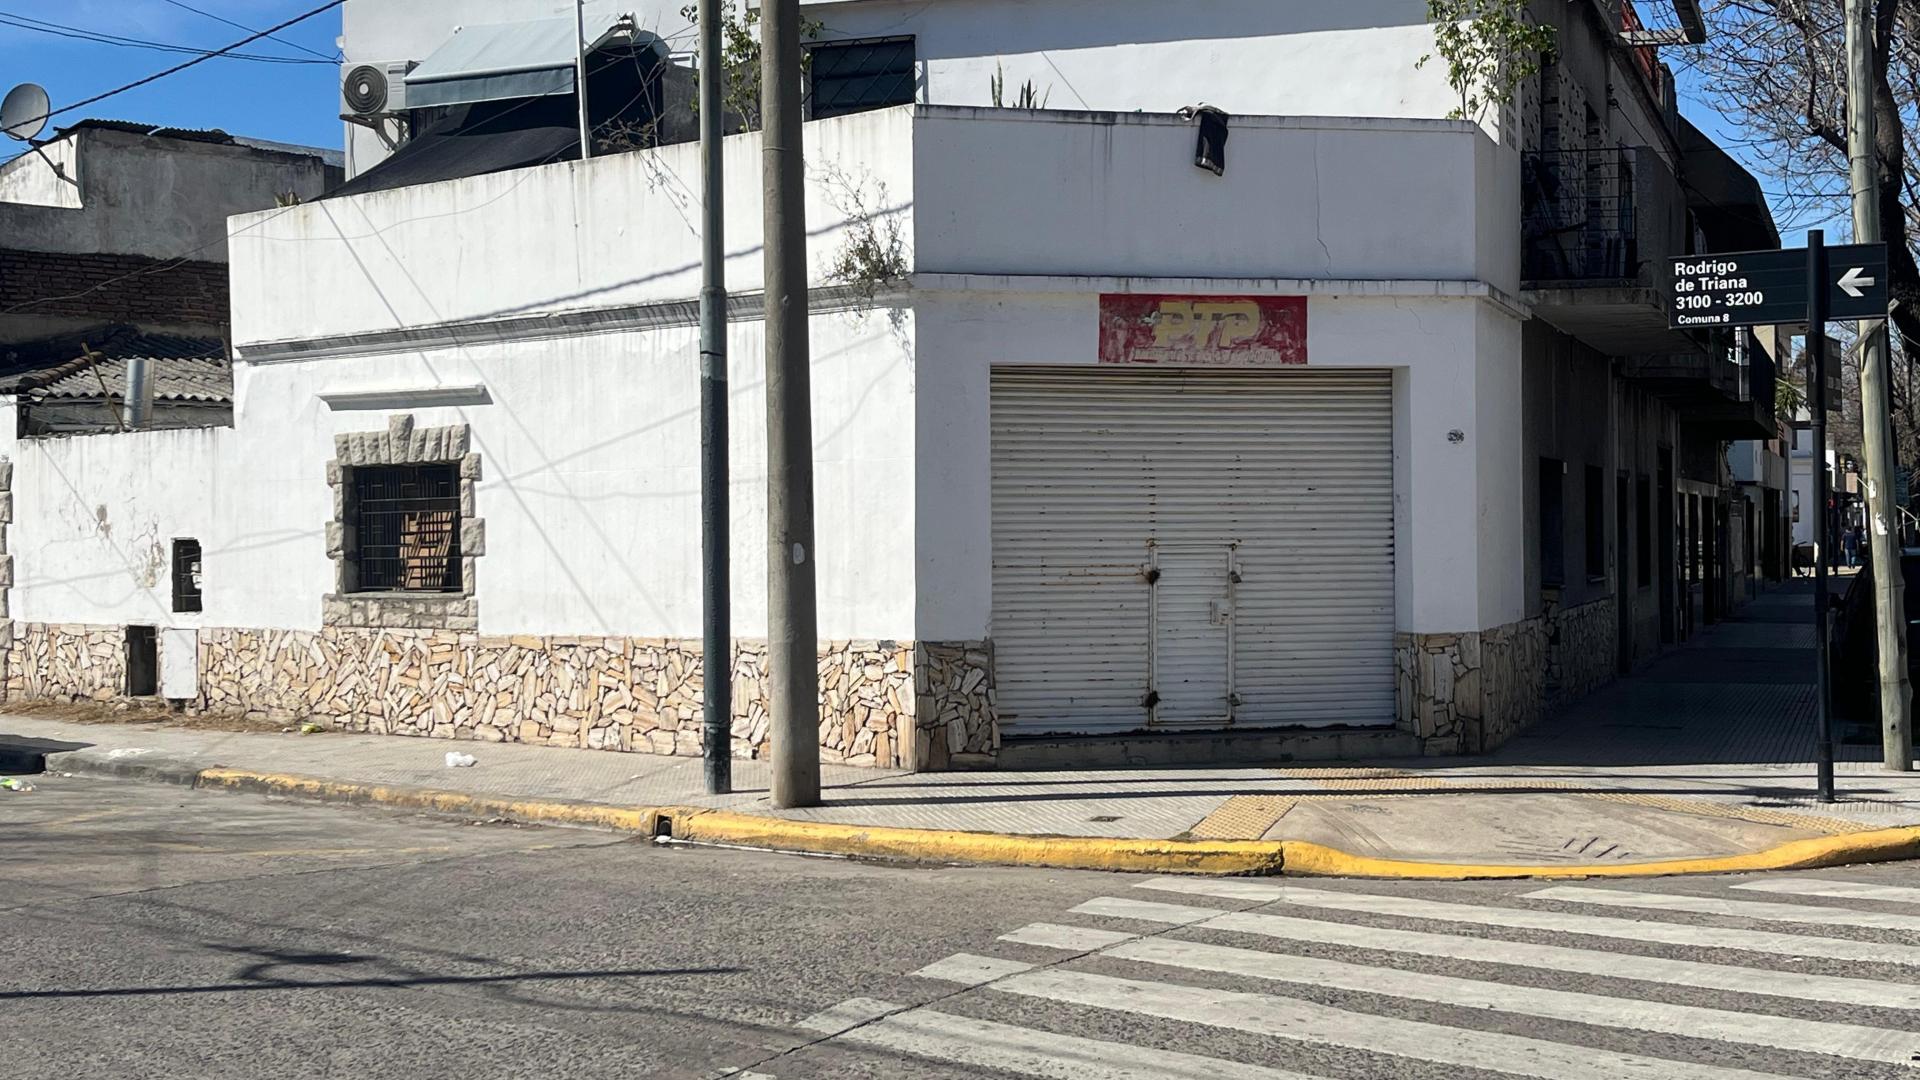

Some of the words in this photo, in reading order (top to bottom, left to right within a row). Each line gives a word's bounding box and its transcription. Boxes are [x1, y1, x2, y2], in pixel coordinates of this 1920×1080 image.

[1675, 260, 1737, 275] Rodrigo
[1675, 279, 1694, 292] de
[1698, 277, 1747, 290] Triana
[1676, 295, 1711, 309] 3100
[1726, 292, 1763, 306] 3200
[1678, 315, 1720, 324] Comuna
[1723, 314, 1729, 322] 8
